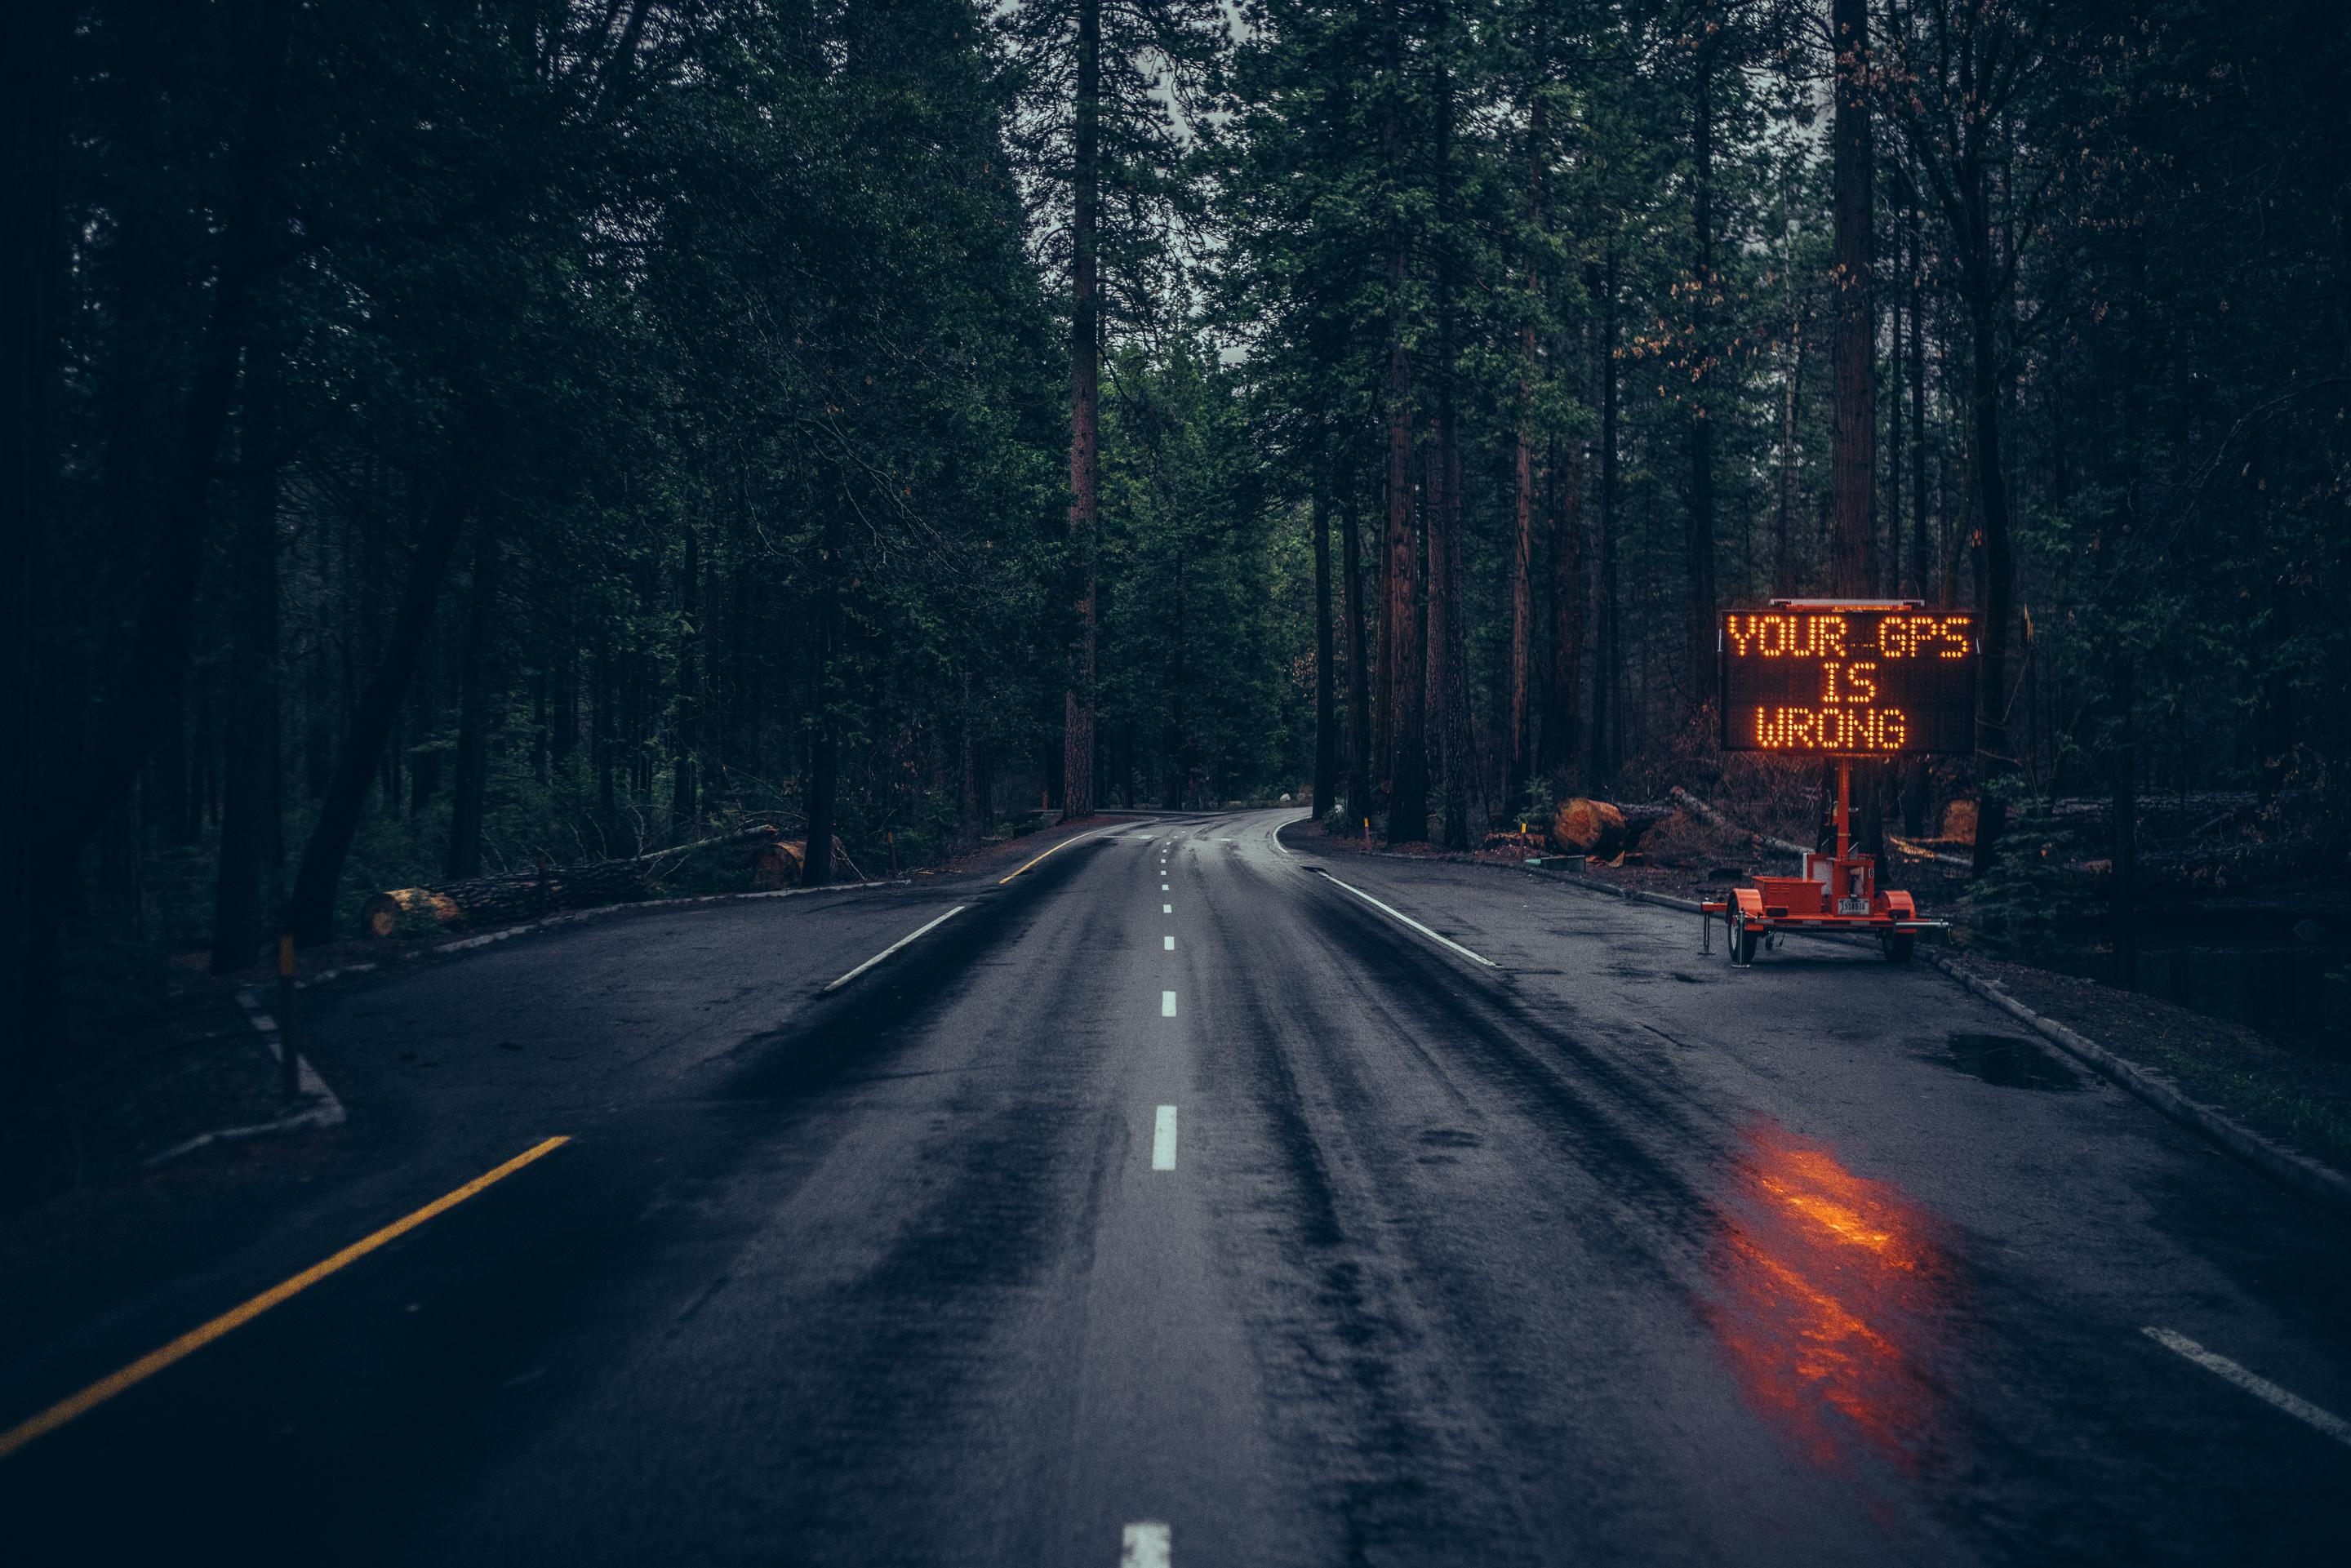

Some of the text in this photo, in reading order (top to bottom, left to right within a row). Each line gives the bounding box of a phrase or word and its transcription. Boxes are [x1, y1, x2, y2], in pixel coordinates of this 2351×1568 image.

[1727, 615, 1970, 658] YOUR GPS
[1821, 662, 1876, 703] IS
[1756, 707, 1906, 748] WRONG
